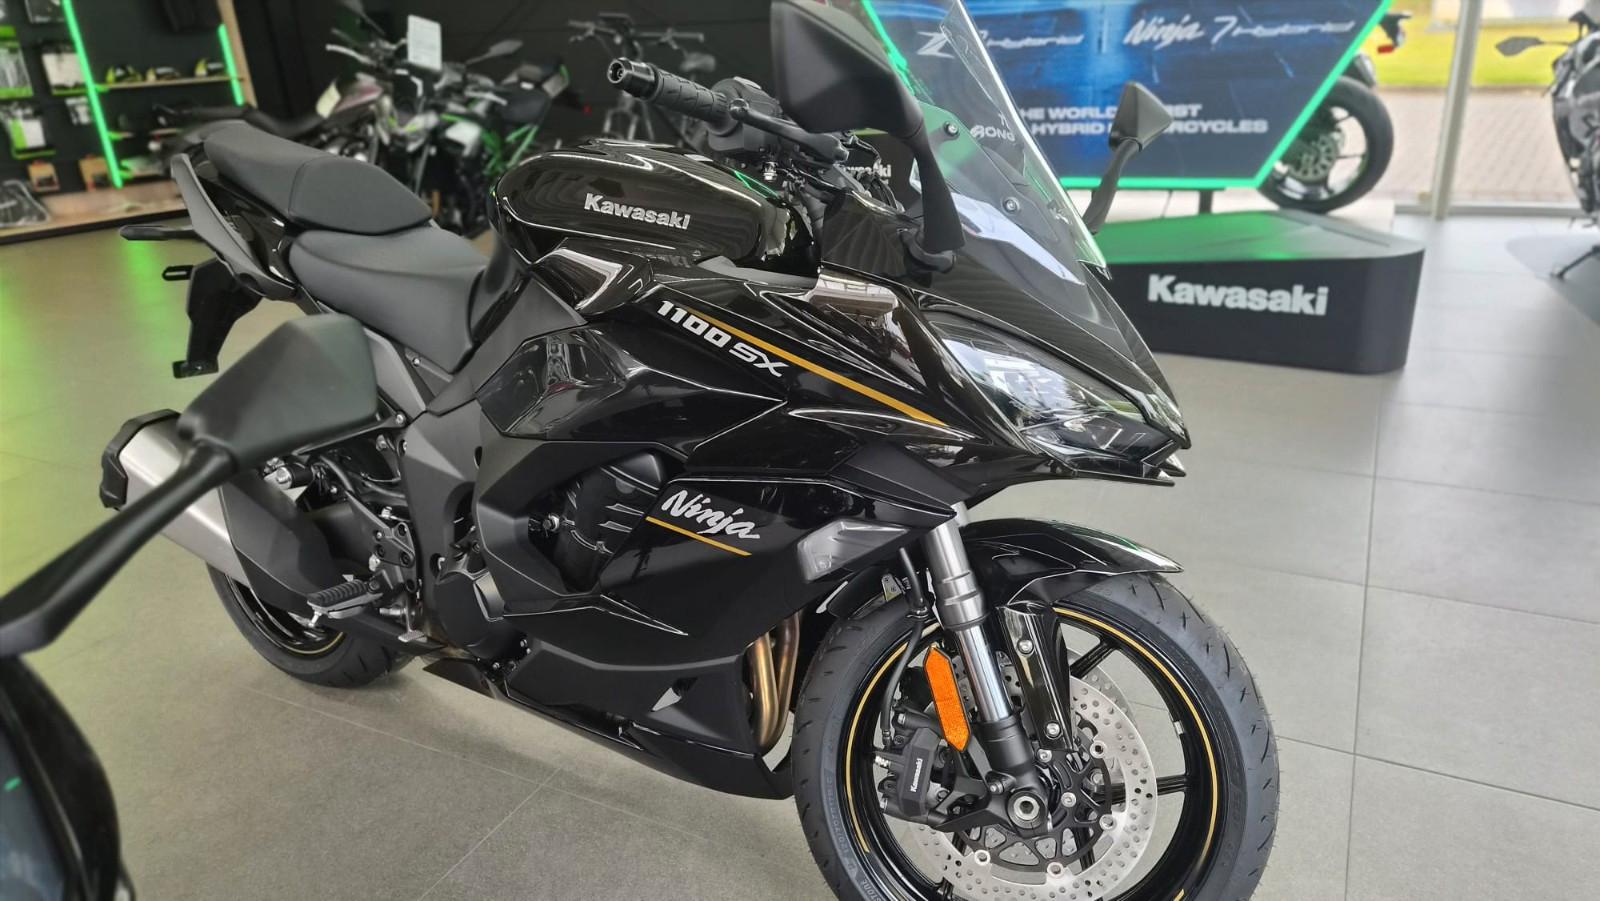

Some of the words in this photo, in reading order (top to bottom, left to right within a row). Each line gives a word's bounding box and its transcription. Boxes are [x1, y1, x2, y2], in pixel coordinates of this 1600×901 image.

[1123, 14, 1205, 50] Ninja
[1210, 15, 1238, 45] 7
[1031, 121, 1106, 135] HYBRID
[1047, 105, 1119, 120] WORLD
[584, 192, 691, 230] Kawasaki
[1148, 273, 1329, 316] Kawasaki
[657, 300, 732, 348] 1100
[728, 342, 790, 378] SX
[661, 489, 761, 539] Ninja
